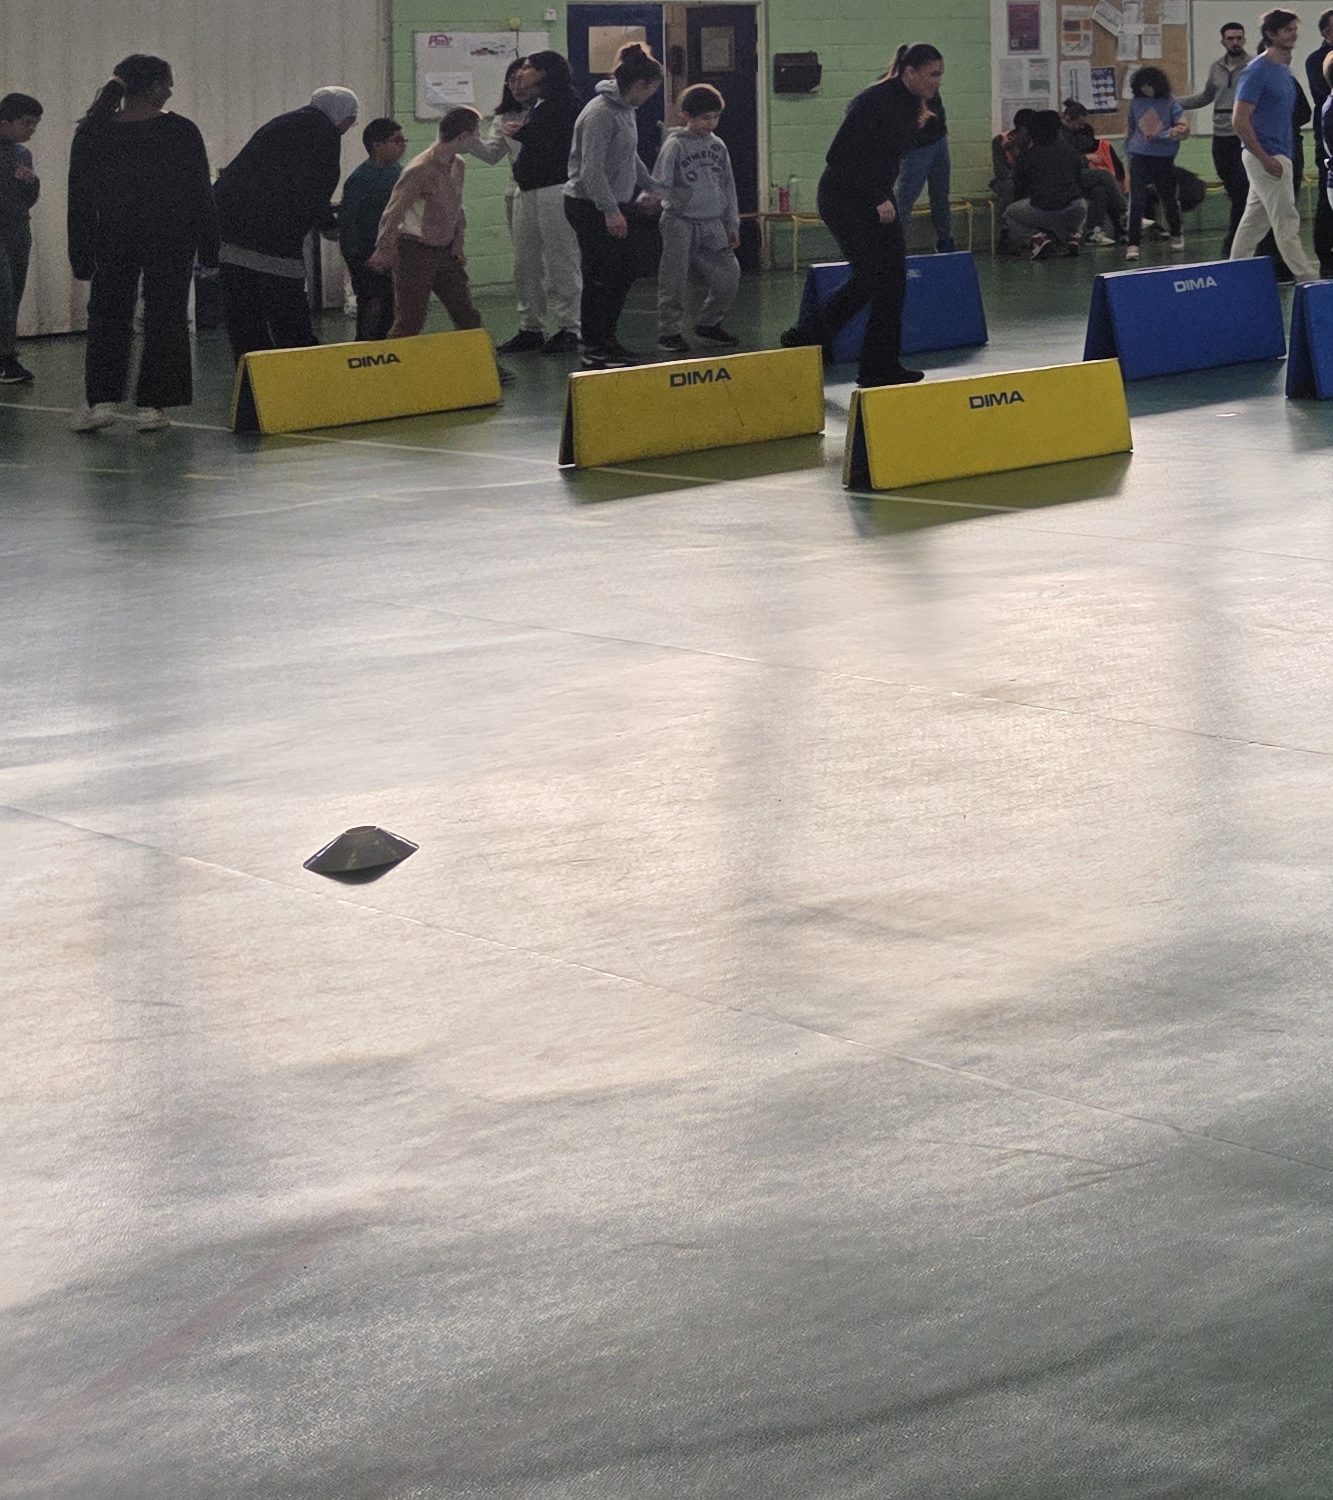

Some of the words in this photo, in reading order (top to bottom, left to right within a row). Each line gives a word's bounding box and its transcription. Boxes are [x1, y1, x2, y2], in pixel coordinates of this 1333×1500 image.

[1173, 275, 1218, 293] DIMA
[347, 353, 402, 369] DIMA
[670, 367, 732, 388] DIMA
[969, 390, 1025, 409] DIMA
